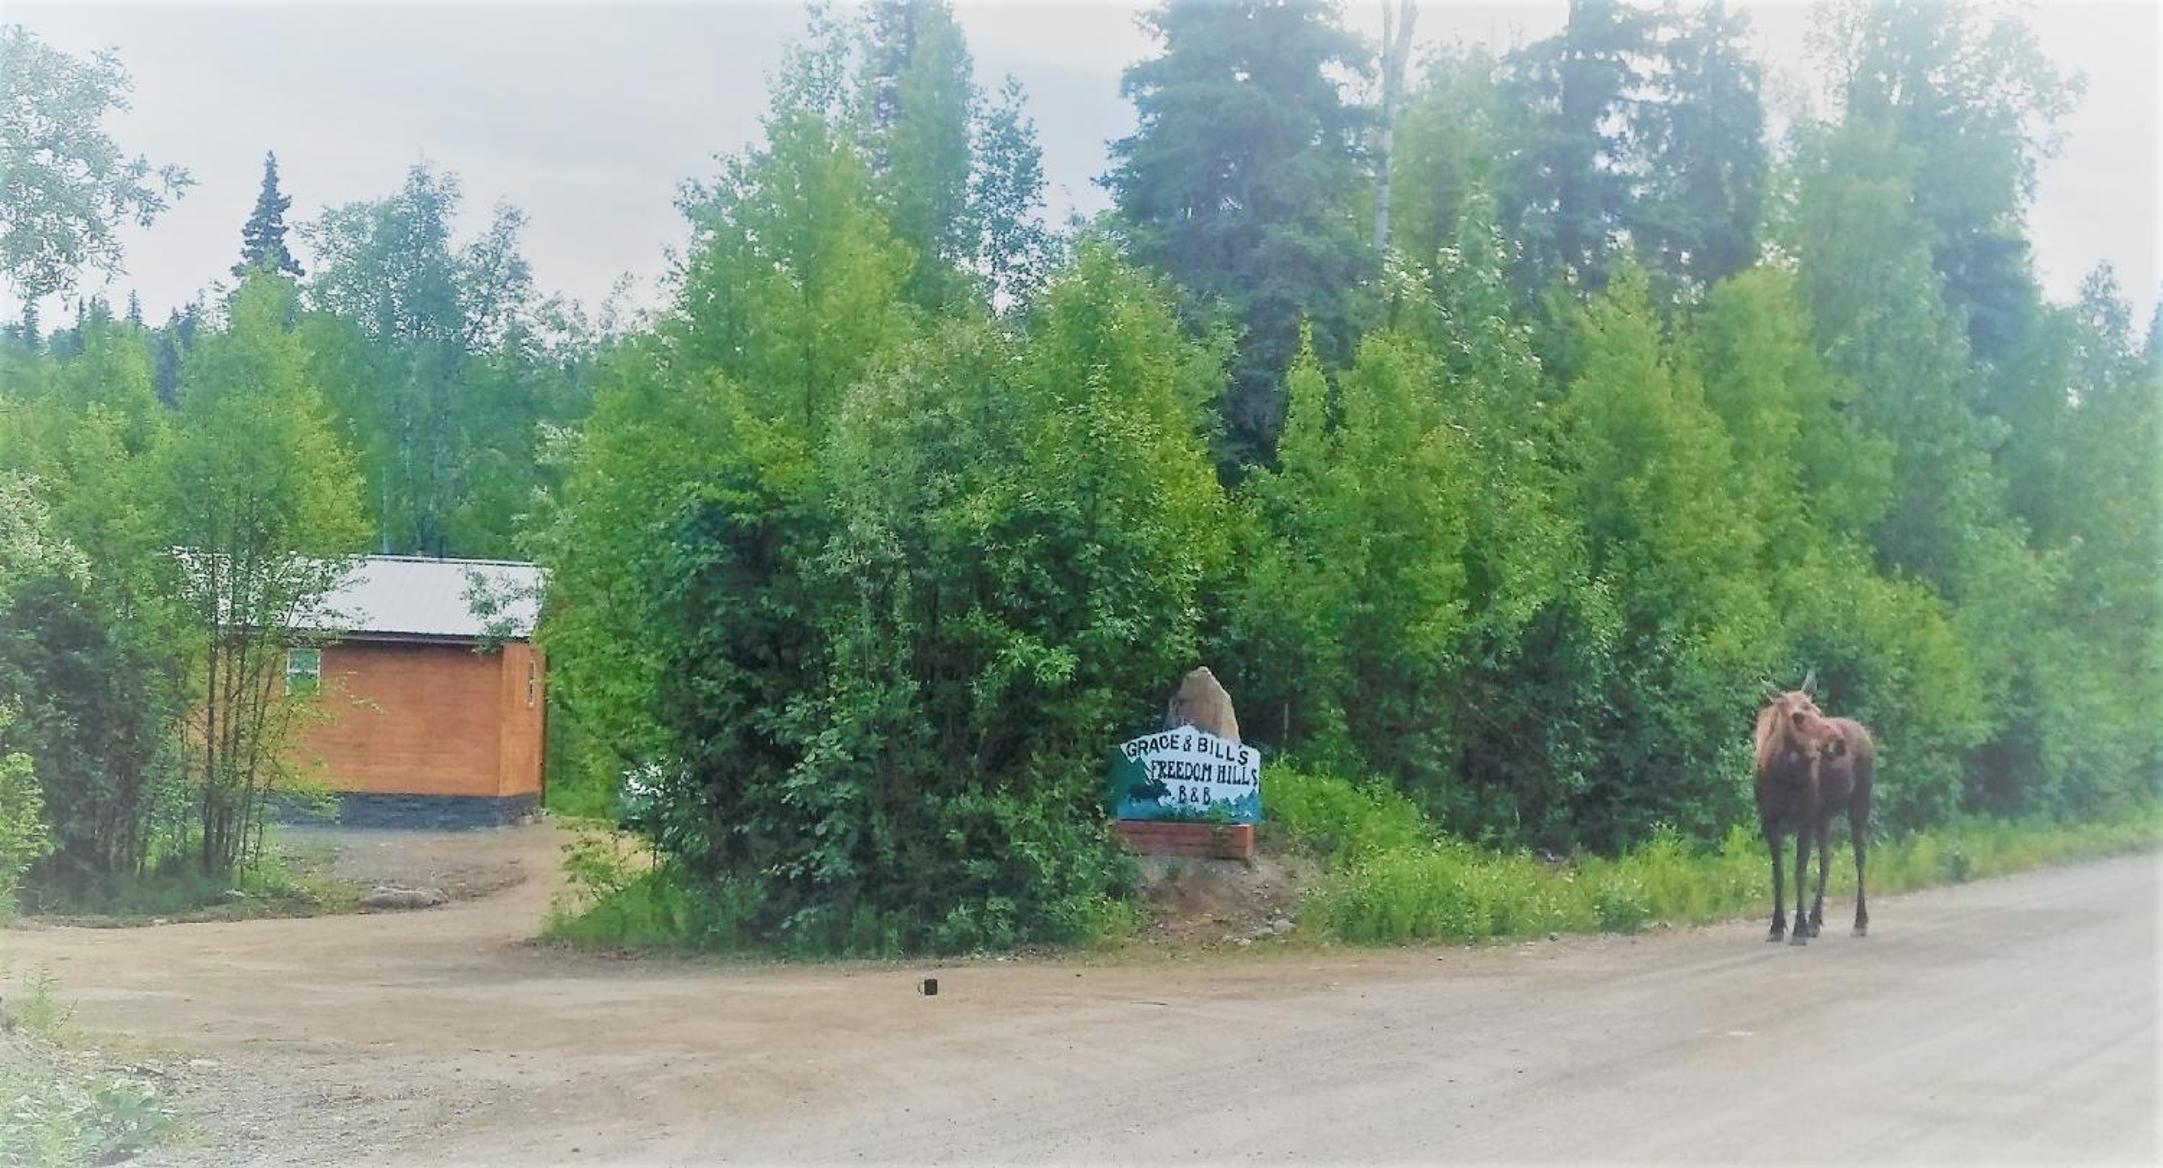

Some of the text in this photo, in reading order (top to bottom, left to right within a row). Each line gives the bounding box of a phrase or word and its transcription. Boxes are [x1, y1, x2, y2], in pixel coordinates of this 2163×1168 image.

[1126, 734, 1249, 766] GRACE & BILL'S
[1151, 760, 1258, 786] FREEDOM HILLS
